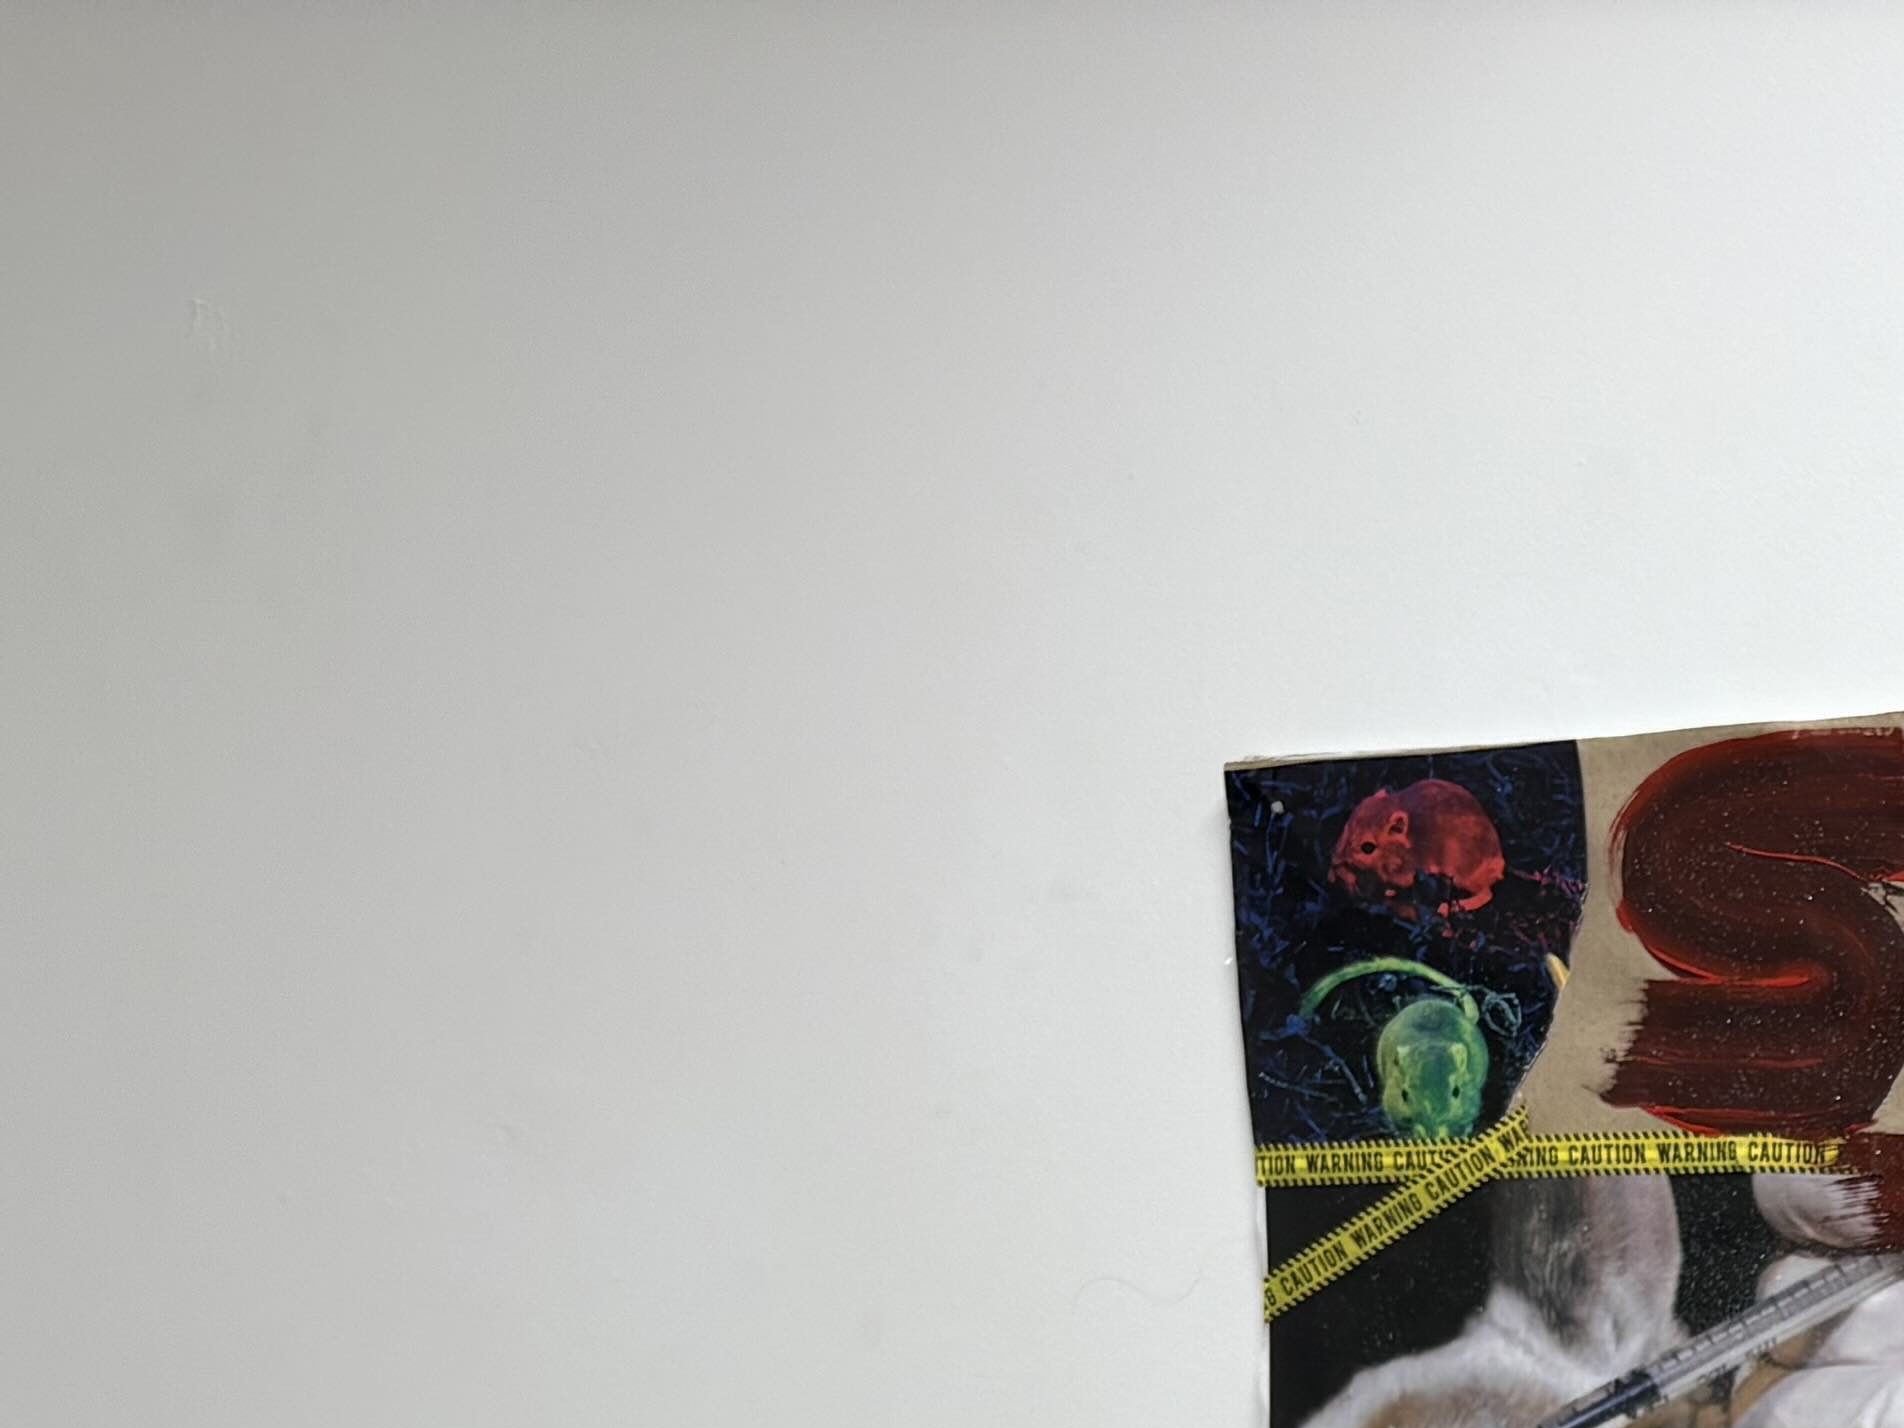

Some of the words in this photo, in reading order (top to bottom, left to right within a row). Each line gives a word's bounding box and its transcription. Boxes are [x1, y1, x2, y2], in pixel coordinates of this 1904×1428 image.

[1306, 1152, 1383, 1173] WARNING
[1568, 1143, 1646, 1165] CAUTION
[1656, 1141, 1737, 1164] WARNING
[1280, 1242, 1349, 1296] CAUTION
[1350, 1192, 1423, 1251] WARNING
[1425, 1146, 1496, 1201] CAUTION
